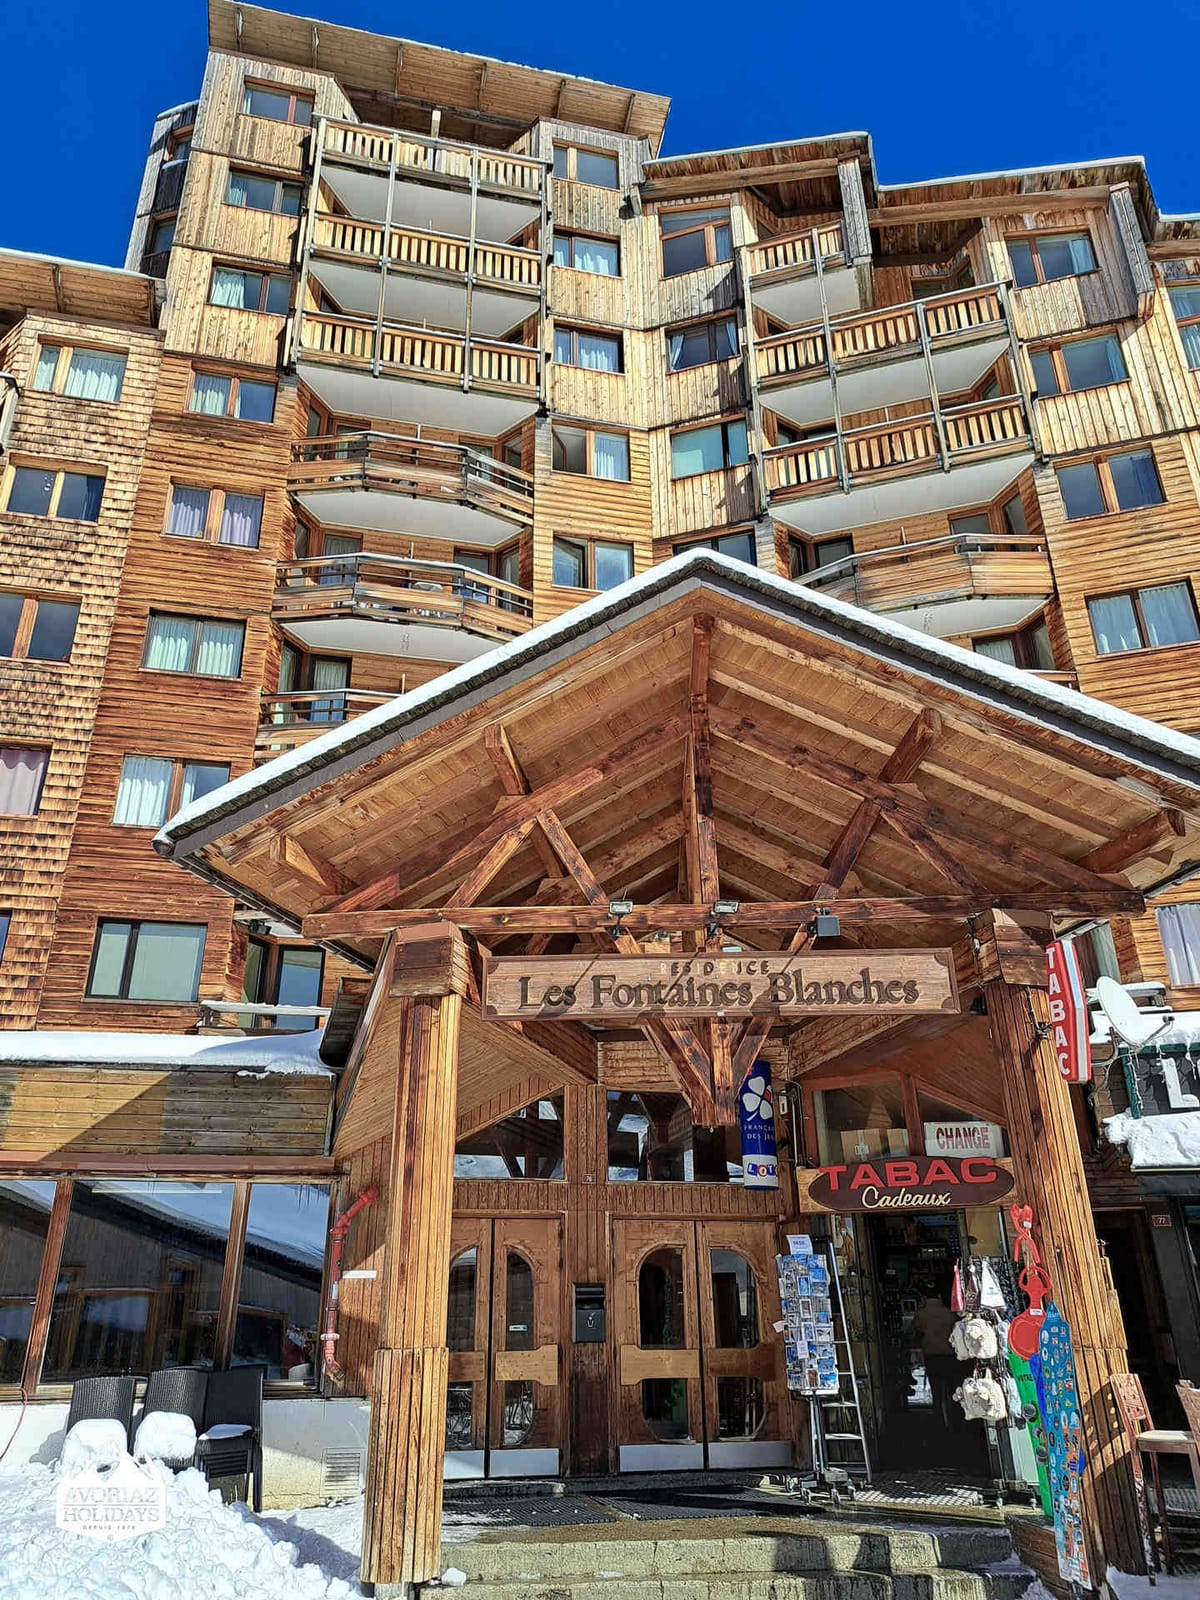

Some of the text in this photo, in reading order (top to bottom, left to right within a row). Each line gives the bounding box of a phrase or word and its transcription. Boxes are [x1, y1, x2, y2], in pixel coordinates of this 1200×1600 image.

[519, 968, 920, 1009] Les Fontaines Blanches
[1046, 946, 1071, 1076] TABAC
[935, 1126, 991, 1150] CHANGE
[819, 1157, 998, 1191] TABAC
[861, 1186, 951, 1208] Cadeaux
